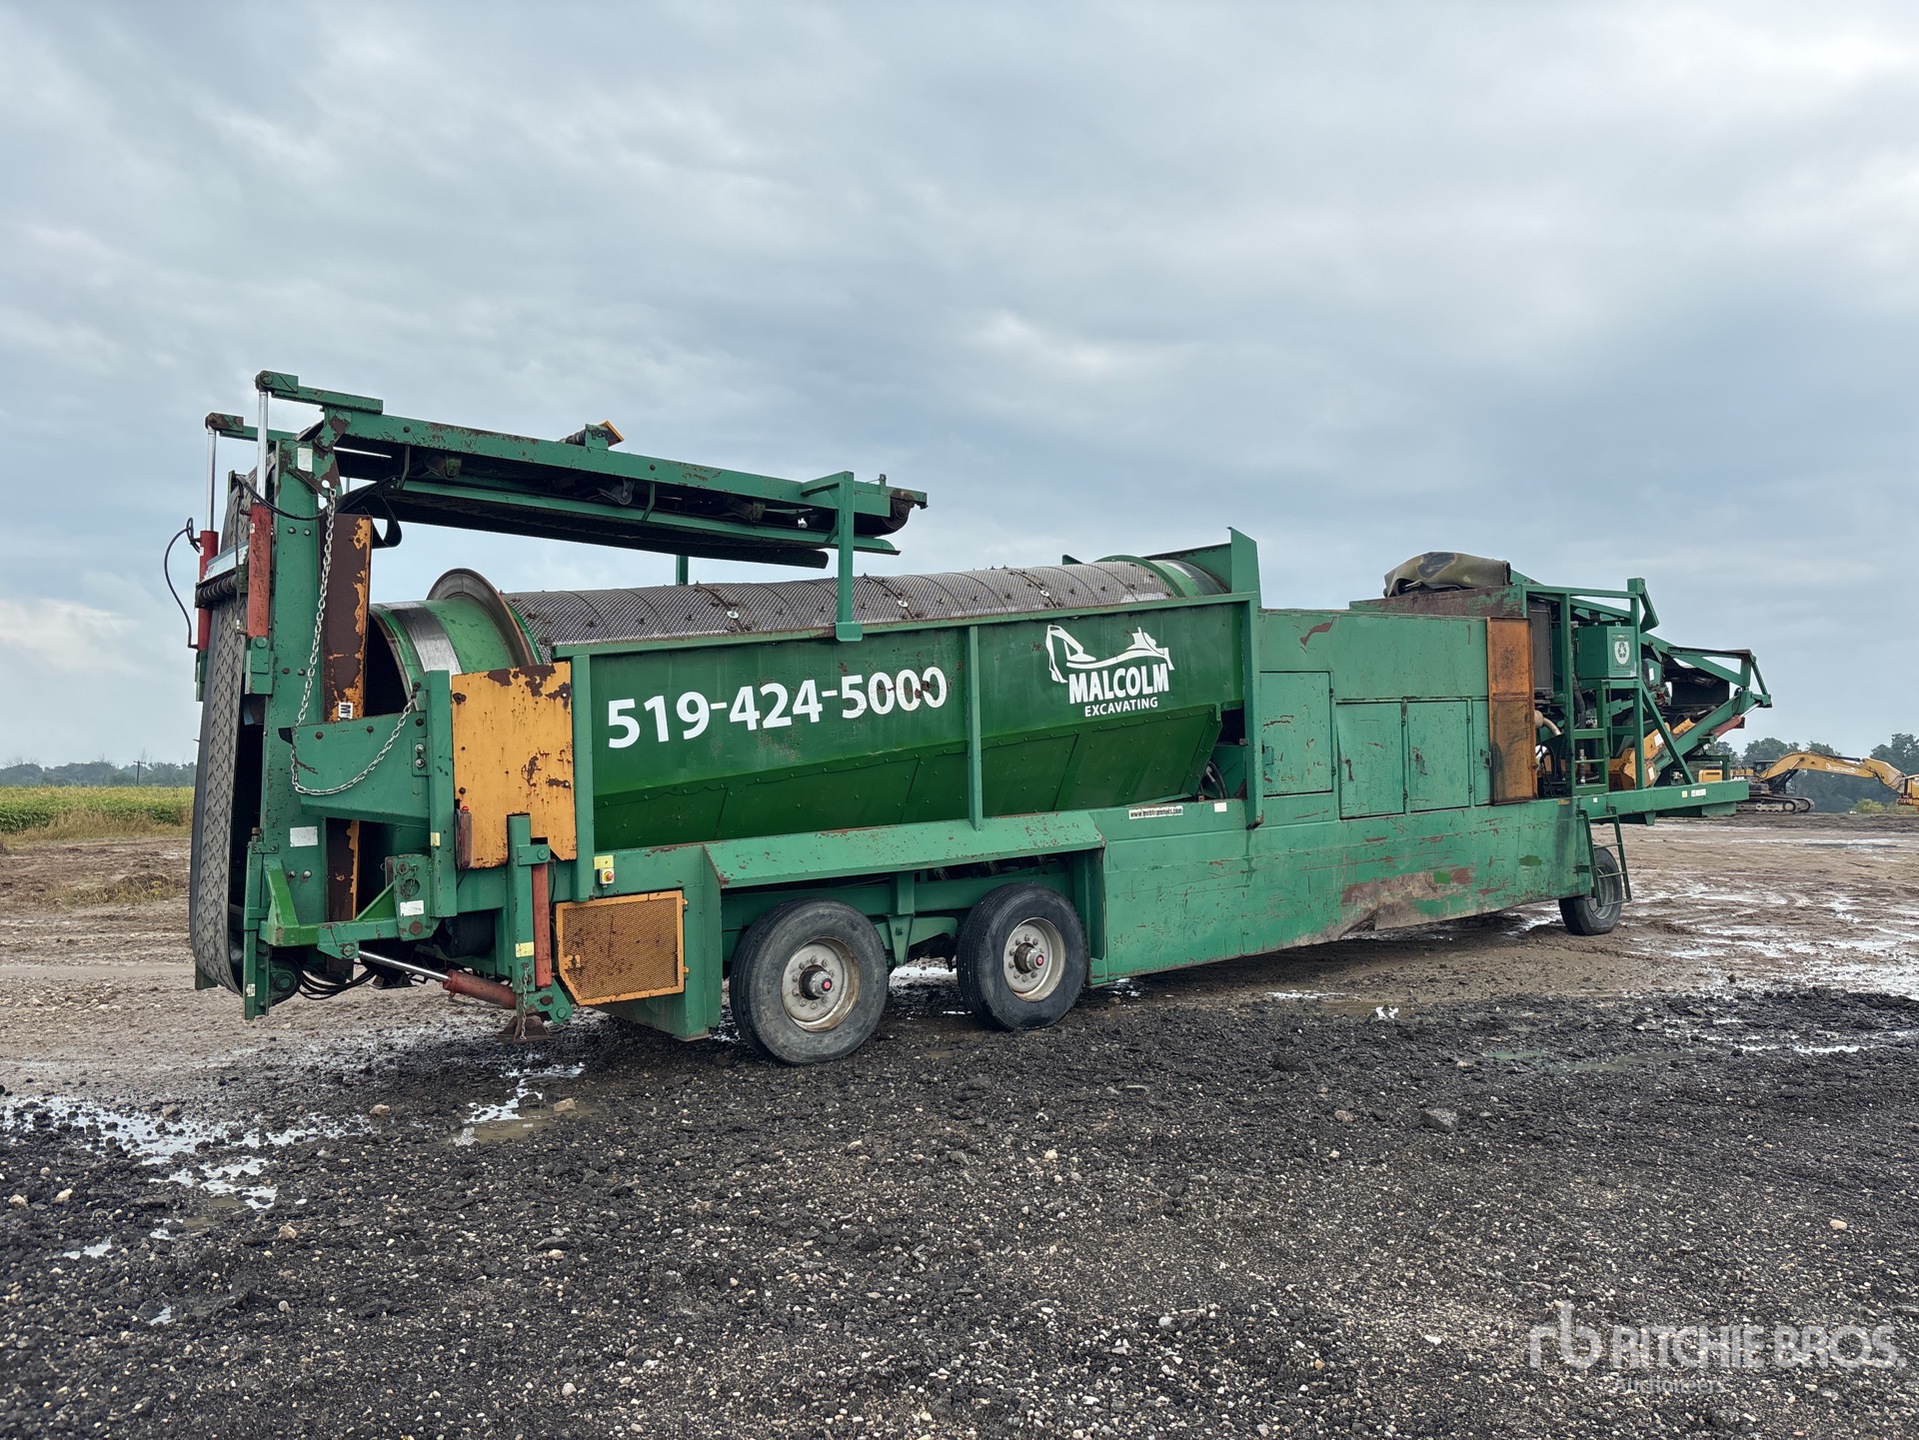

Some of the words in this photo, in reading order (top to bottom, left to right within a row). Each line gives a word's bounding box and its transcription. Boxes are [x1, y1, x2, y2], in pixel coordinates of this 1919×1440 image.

[1068, 663, 1170, 704] MALCOLM
[608, 666, 948, 749] 519-424-5000
[1084, 696, 1159, 717] EXCAVATING
